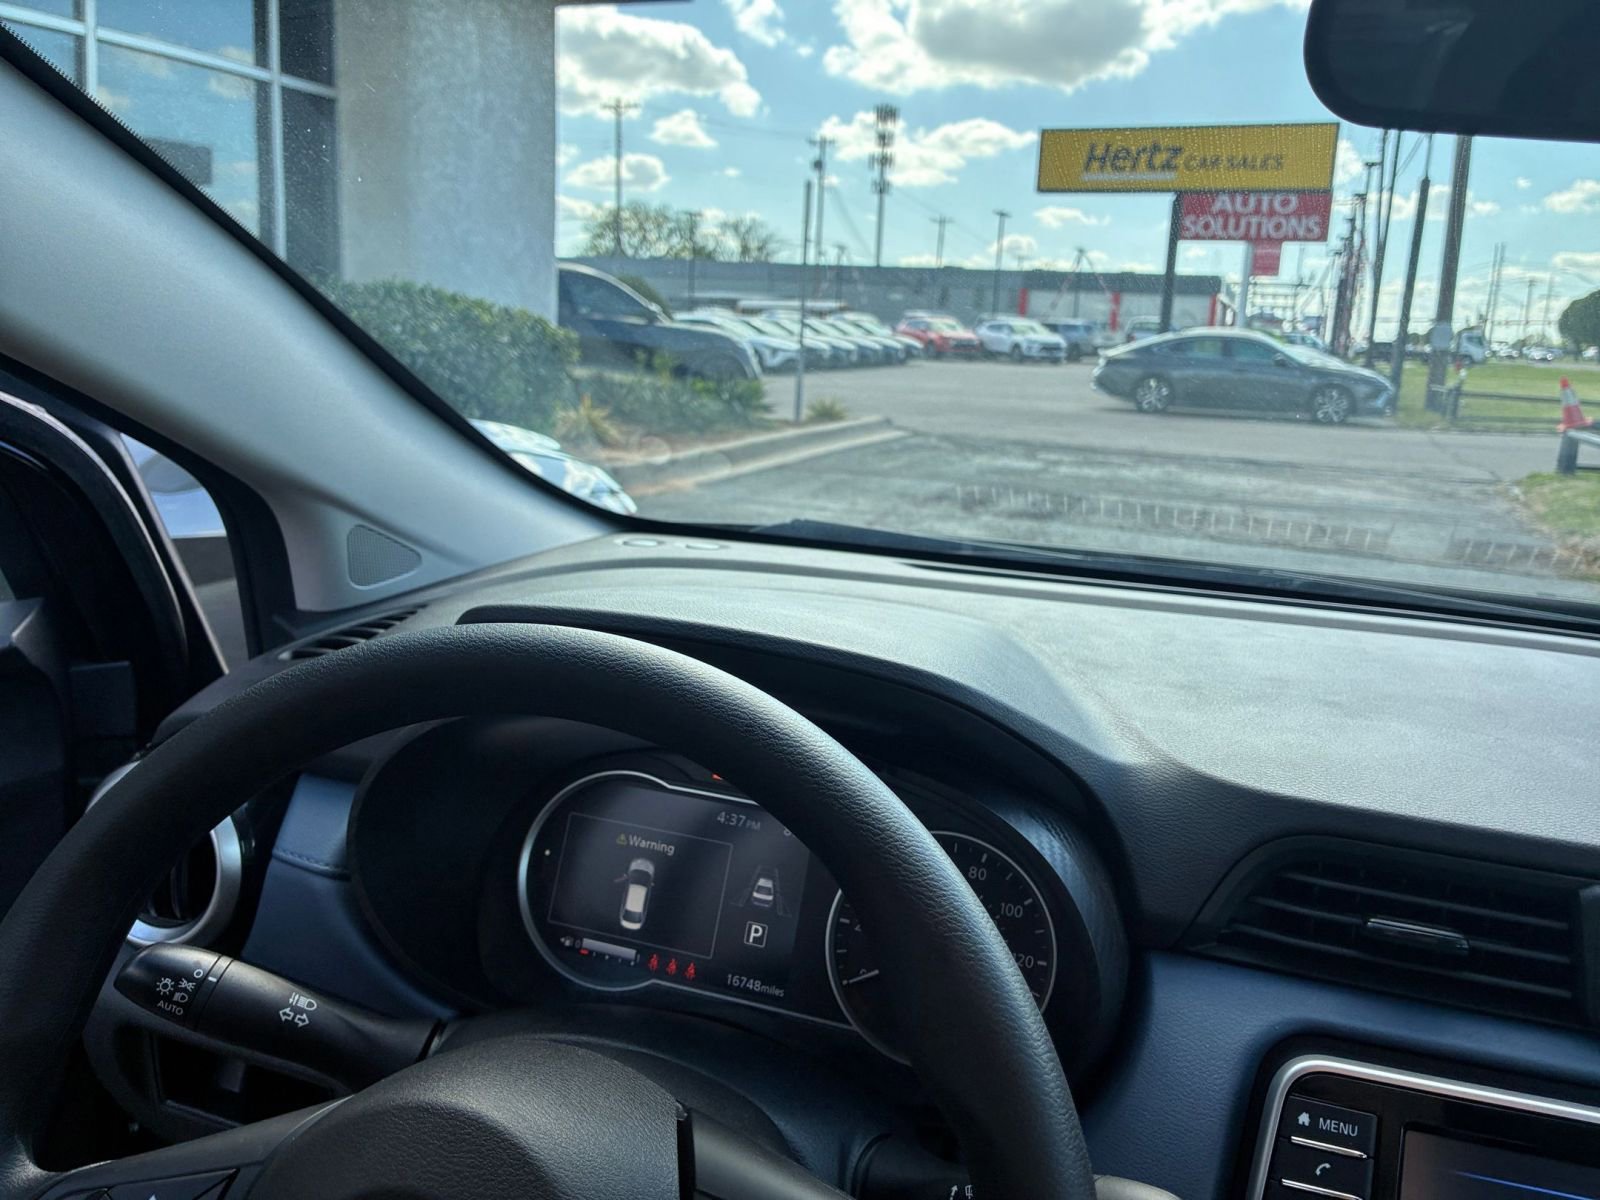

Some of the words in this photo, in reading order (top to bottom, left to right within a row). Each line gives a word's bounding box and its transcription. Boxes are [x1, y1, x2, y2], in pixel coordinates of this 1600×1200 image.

[1085, 142, 1184, 174] Hertz
[1184, 153, 1222, 172] CAR
[1211, 192, 1298, 215] AUTO
[1182, 213, 1321, 240] SOLUTIONS
[629, 834, 675, 856] Warning
[968, 866, 987, 880] 80
[1000, 902, 1023, 918] 100
[749, 924, 763, 943] P
[157, 1000, 184, 1016] AUTO
[1318, 1117, 1358, 1137] MENU
